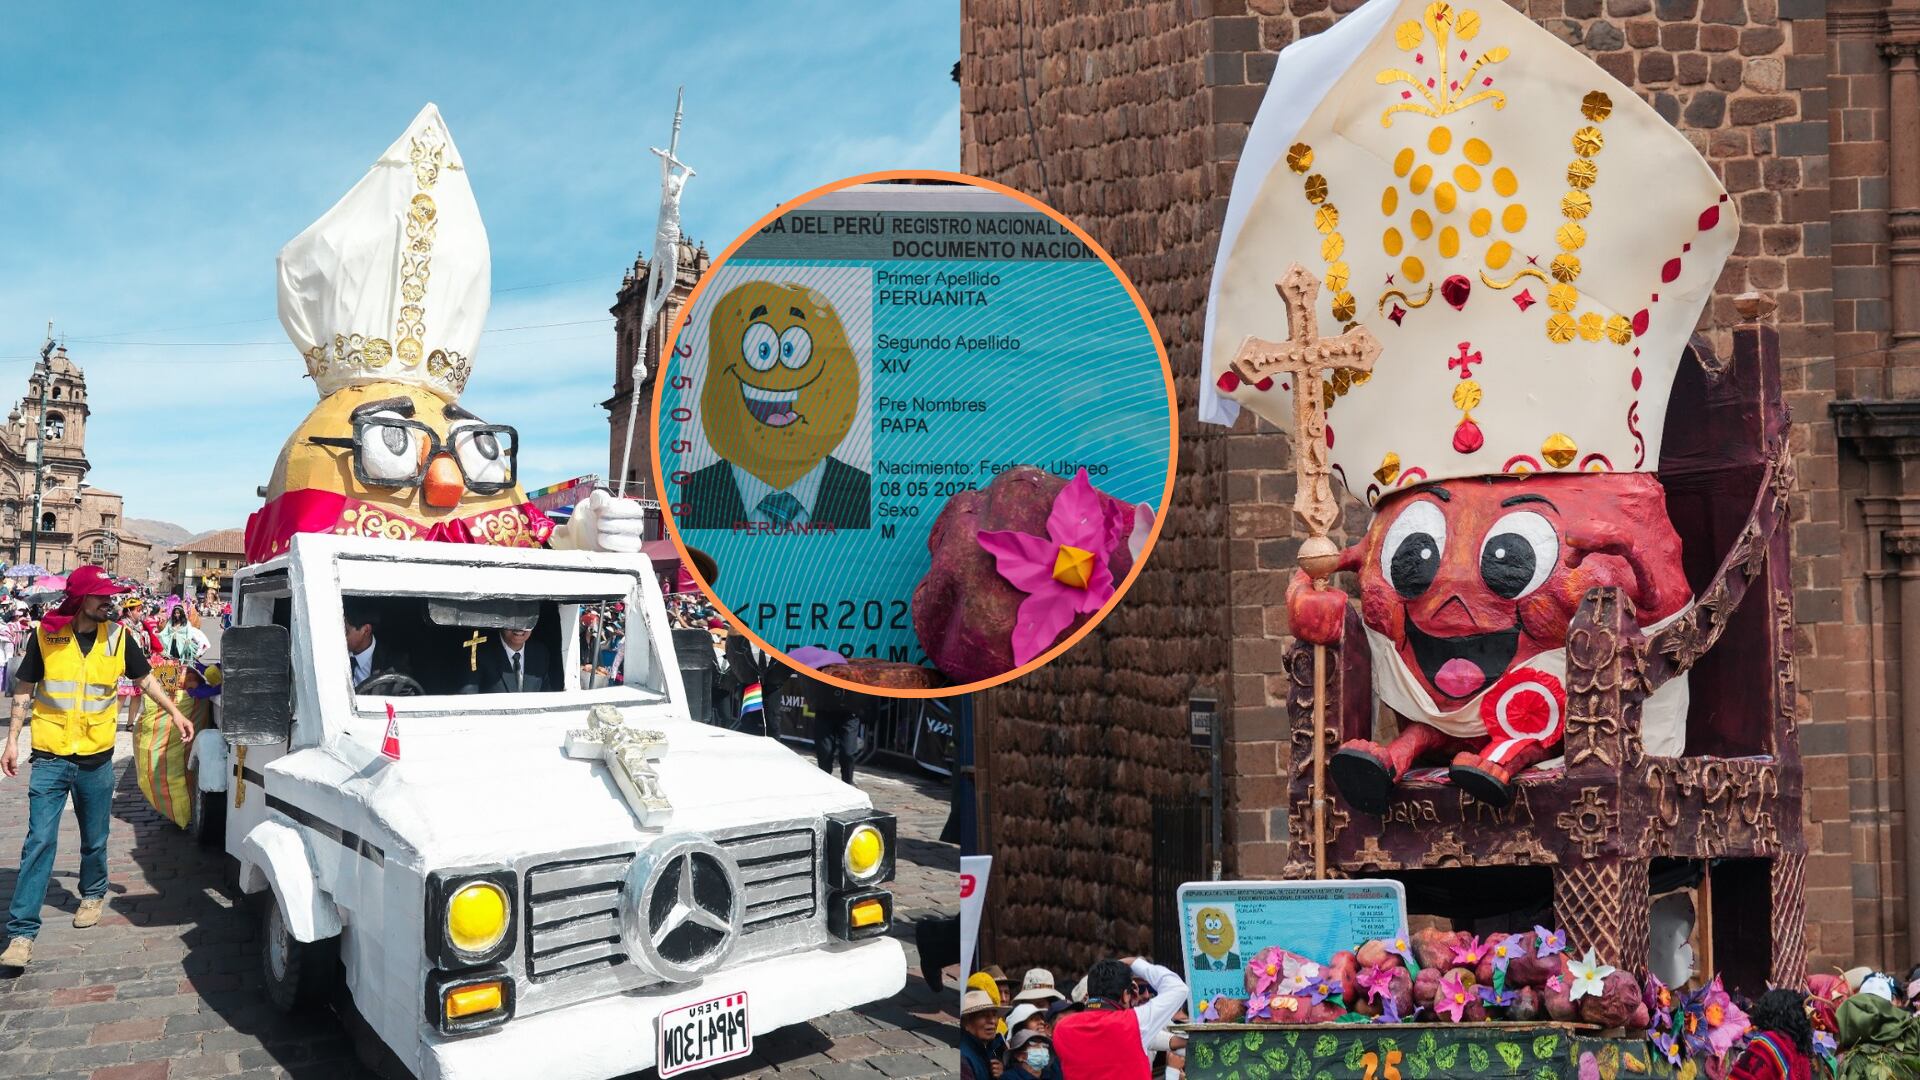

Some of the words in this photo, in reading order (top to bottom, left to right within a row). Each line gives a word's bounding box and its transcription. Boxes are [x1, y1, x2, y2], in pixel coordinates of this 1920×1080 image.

[792, 217, 828, 234] DEL
[834, 213, 885, 235] PERÚ
[892, 217, 972, 234] REGISTRO
[976, 218, 1056, 236] NACIONAL
[1060, 223, 1076, 236] D
[893, 240, 1015, 258] DOCUMENTO
[1021, 241, 1099, 259] NACION
[877, 271, 931, 287] Primer
[935, 271, 1000, 288] Apellido
[879, 290, 987, 306] PERUANITA
[877, 335, 952, 353] Segundo
[956, 335, 1021, 351] Apellido
[880, 358, 911, 374] XIV
[879, 397, 906, 412] Pre
[913, 397, 987, 412] Nombres
[880, 418, 928, 434] PAPA
[878, 460, 974, 475] Nacimiento:
[880, 482, 900, 497] 08
[907, 482, 928, 497] 05
[934, 482, 977, 497] 2025
[878, 502, 919, 517] Sexo
[733, 521, 837, 536] PERUANITA
[881, 524, 895, 538] M
[1360, 1050, 1402, 1080] 25
